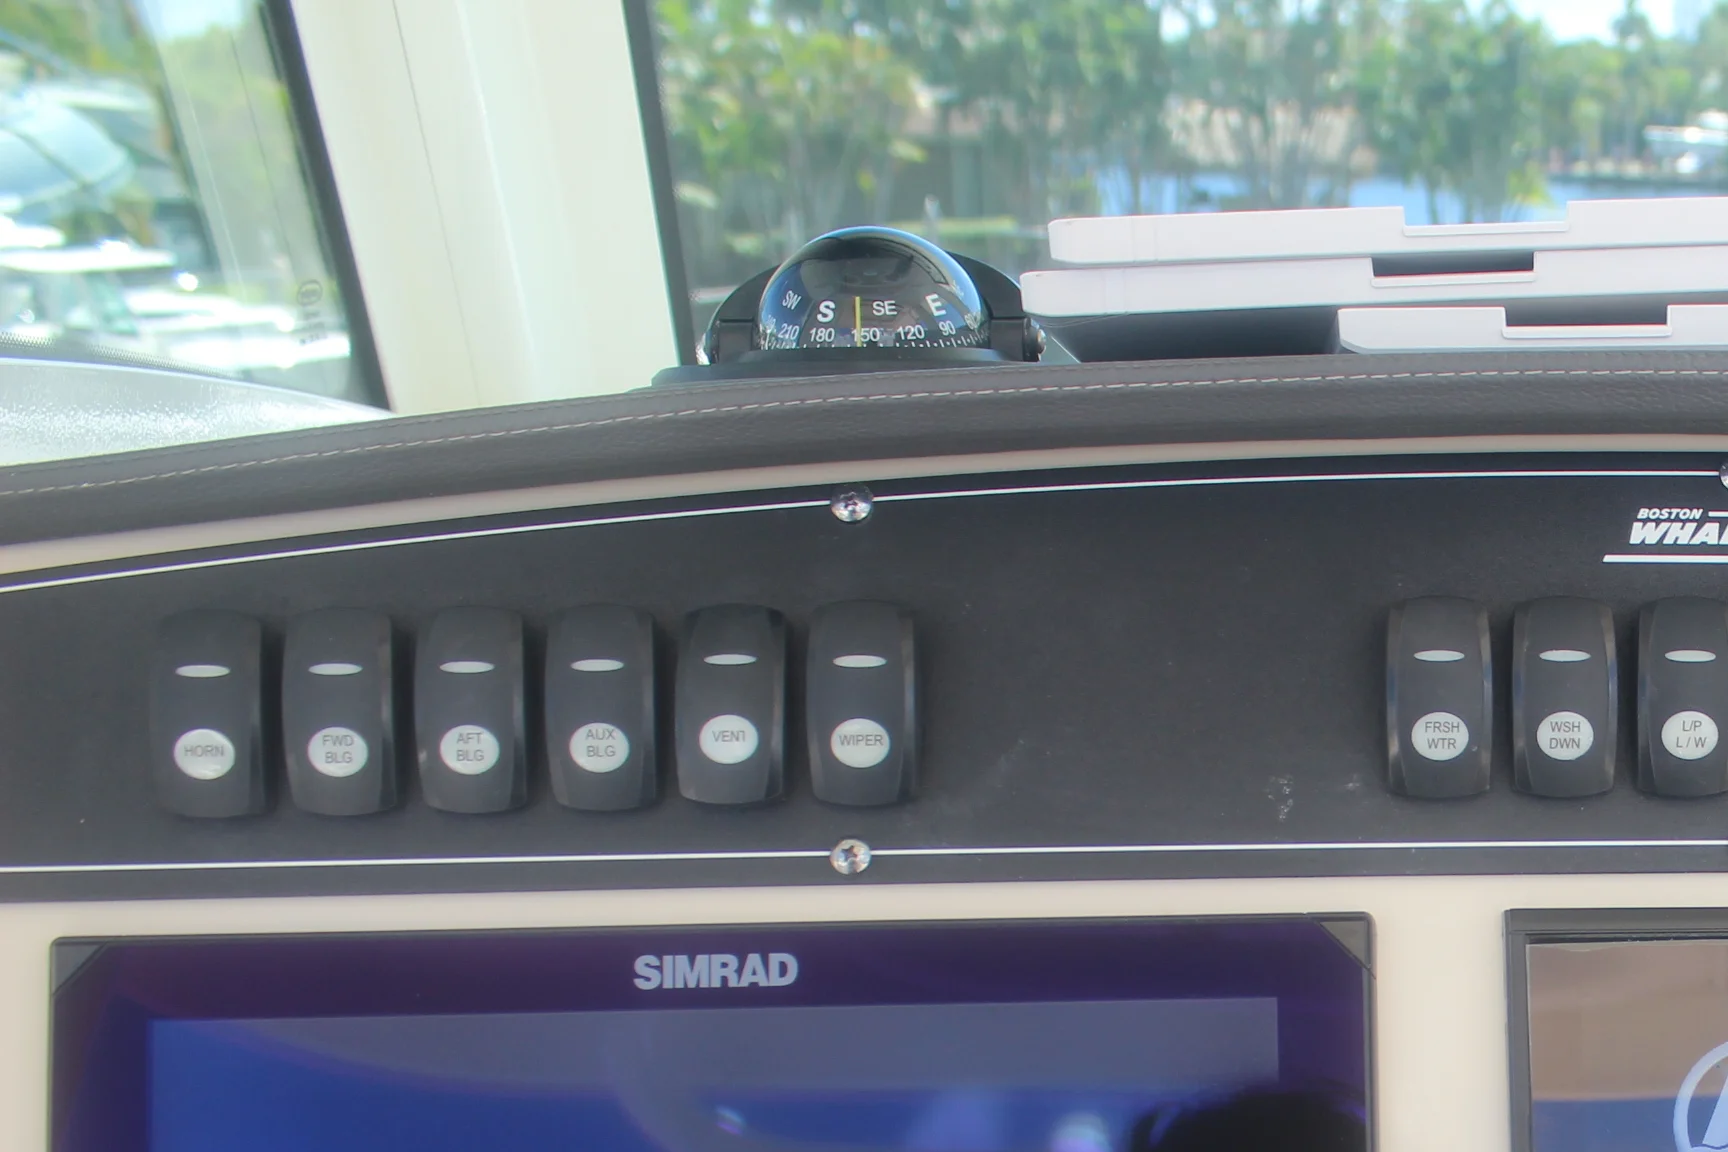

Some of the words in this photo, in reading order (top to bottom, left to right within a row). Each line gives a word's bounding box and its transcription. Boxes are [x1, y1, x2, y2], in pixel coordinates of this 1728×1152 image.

[782, 290, 802, 310] SW
[816, 300, 836, 324] S
[872, 301, 897, 316] SE
[925, 293, 947, 317] E
[777, 322, 800, 340] 210
[809, 327, 836, 342] 180
[851, 327, 880, 342] 150
[898, 325, 926, 340] 120
[938, 320, 956, 336] 90
[1636, 507, 1703, 520] BOSTON
[1424, 721, 1460, 734] FRSH
[1550, 721, 1581, 733] WSH
[1681, 720, 1703, 733] L/P
[322, 734, 355, 747] FWD
[456, 732, 484, 746] AFT
[585, 728, 617, 741] AUX
[712, 730, 746, 742] VENT
[838, 734, 885, 747] WIPER
[1427, 737, 1458, 750] WTR
[1549, 737, 1581, 750] DWN
[183, 744, 225, 757] HORN
[325, 750, 354, 764] BLG
[456, 748, 485, 762] BLG
[586, 744, 617, 758] BLG
[633, 952, 799, 991] SIMRAD
